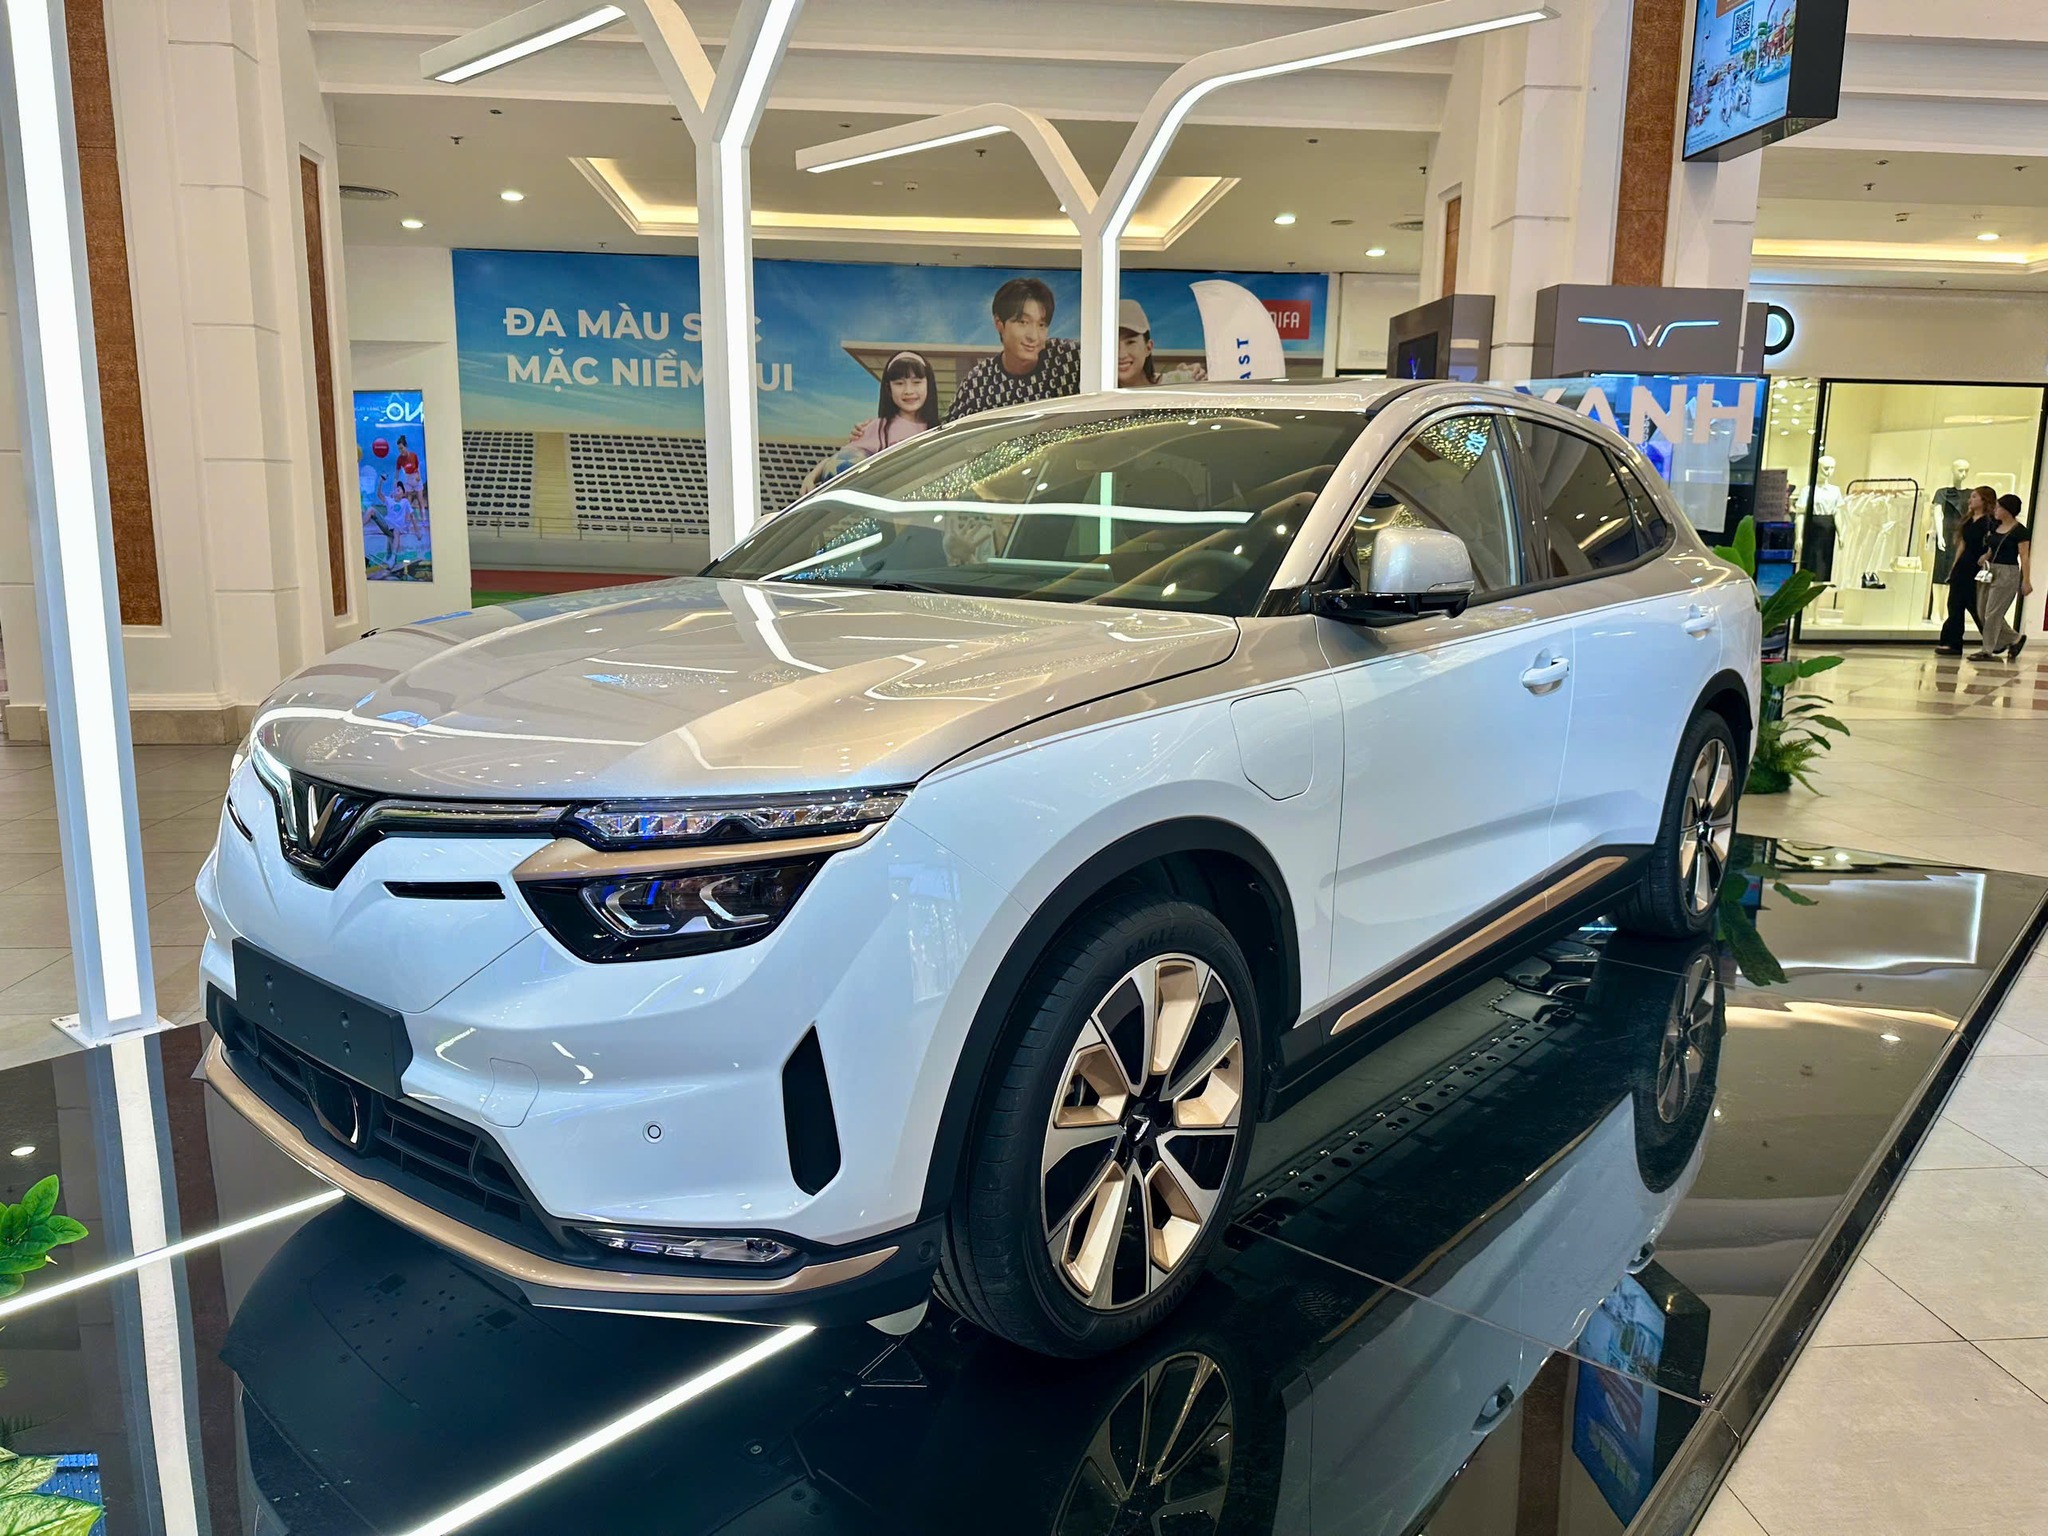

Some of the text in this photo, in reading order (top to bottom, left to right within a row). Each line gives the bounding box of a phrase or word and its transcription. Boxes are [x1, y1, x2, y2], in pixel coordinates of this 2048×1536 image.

[503, 307, 566, 337] ĐA
[578, 302, 669, 340] MÀU
[506, 348, 792, 392] MẶC NIỀM UI
[1514, 382, 1757, 444] ANH
